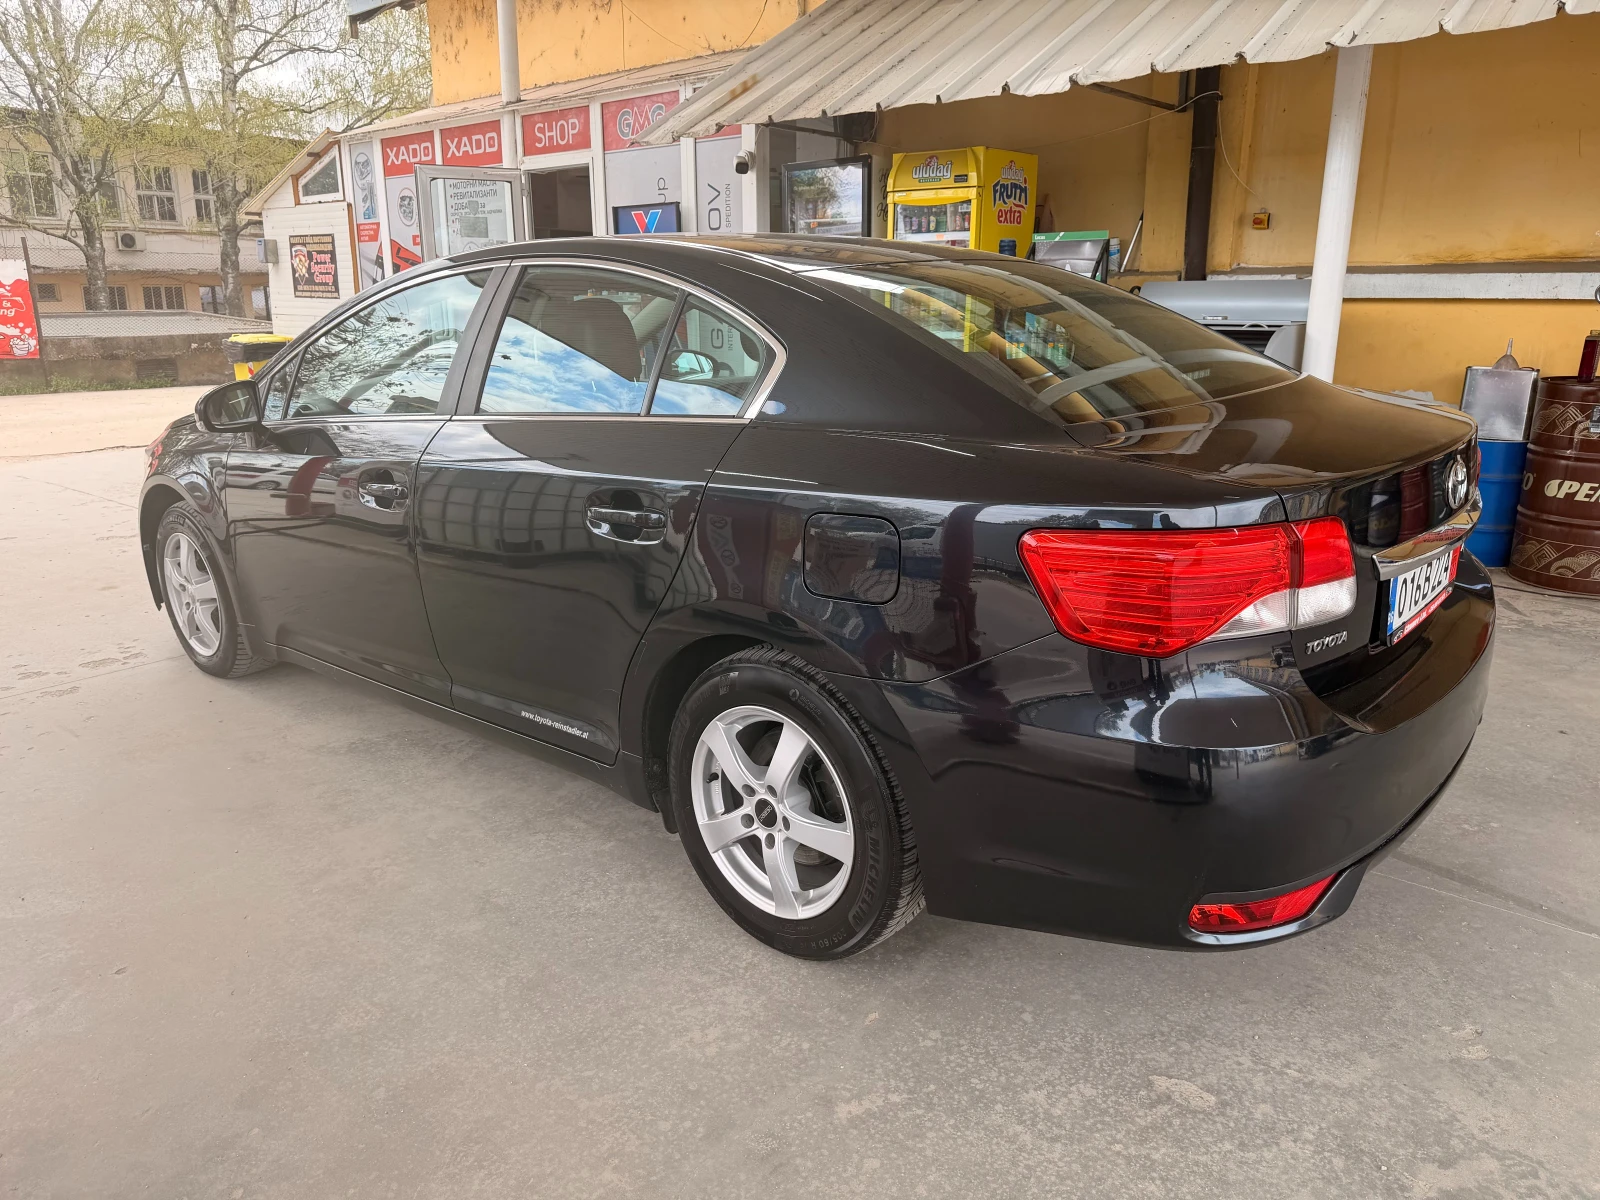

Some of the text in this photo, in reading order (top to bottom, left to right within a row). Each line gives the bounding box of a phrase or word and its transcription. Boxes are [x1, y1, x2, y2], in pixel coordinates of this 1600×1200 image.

[534, 118, 580, 148] SHOP
[386, 142, 433, 166] XADO
[446, 132, 498, 158] XADO
[453, 188, 498, 200] РЕВИТАЛИЗАНТИ
[997, 206, 1022, 225] extra
[312, 252, 331, 262] Power
[311, 261, 335, 275] Security
[314, 272, 334, 285] Group
[1306, 630, 1348, 655] TOYOTA
[851, 835, 880, 924] MICHELIN
